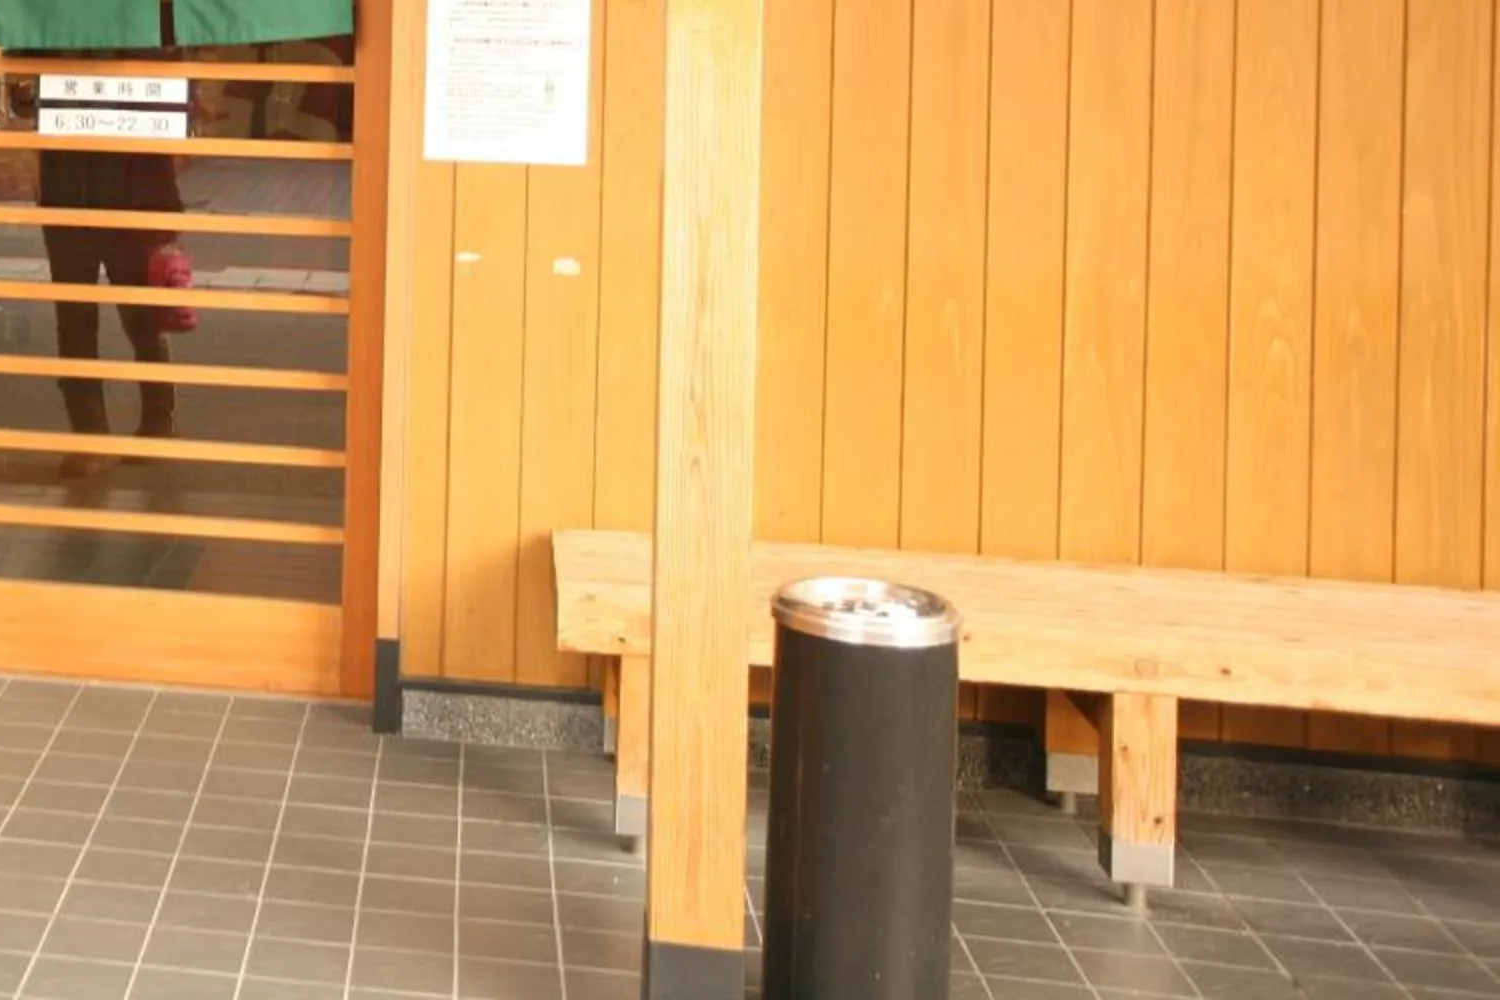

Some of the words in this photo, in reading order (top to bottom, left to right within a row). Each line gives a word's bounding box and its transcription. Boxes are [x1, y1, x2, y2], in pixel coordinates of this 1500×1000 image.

[64, 80, 162, 98] 営業時間
[55, 114, 169, 133] 6:30～2230
